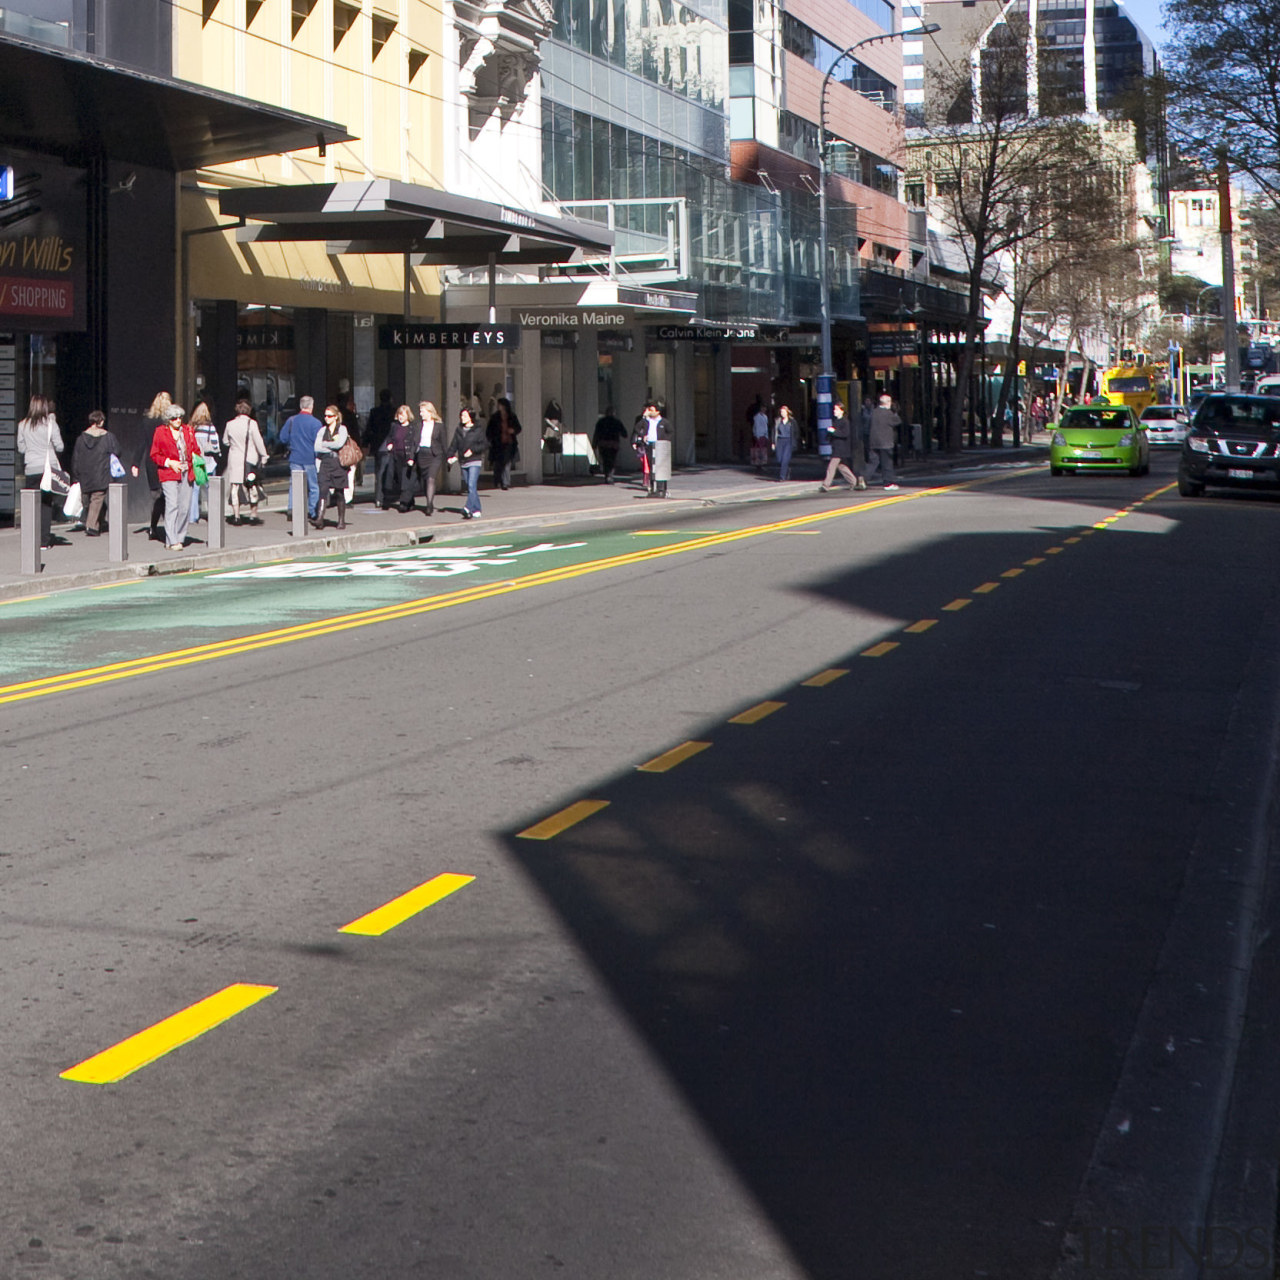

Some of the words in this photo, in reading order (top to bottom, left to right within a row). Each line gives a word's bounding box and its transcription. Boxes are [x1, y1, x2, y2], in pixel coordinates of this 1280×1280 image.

[22, 235, 74, 272] Willis
[10, 285, 66, 310] SHOPPING
[519, 312, 579, 326] Veronika
[582, 312, 625, 325] Maine
[659, 326, 694, 338] Calvin
[696, 326, 722, 338] Klein
[723, 328, 756, 338] Jeans
